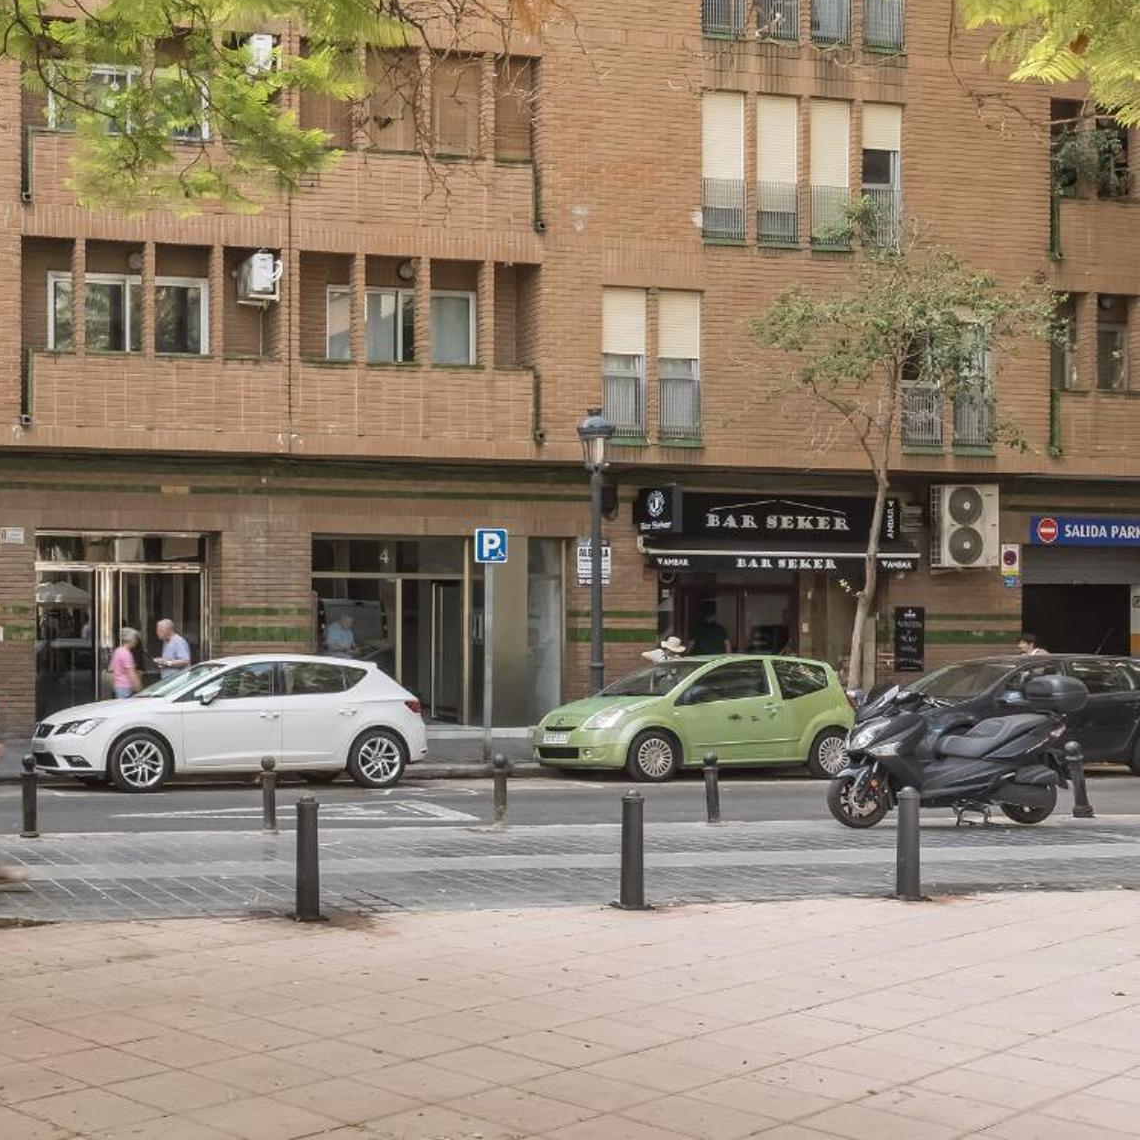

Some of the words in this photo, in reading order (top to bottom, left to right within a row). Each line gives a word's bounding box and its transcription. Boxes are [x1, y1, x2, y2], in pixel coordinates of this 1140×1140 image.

[705, 513, 758, 529] BAR
[766, 515, 850, 531] SEKER
[1064, 524, 1107, 538] SALIDA
[483, 533, 500, 558] P
[380, 548, 390, 563] 4
[736, 558, 773, 568] BAR
[778, 558, 837, 569] SEKER
